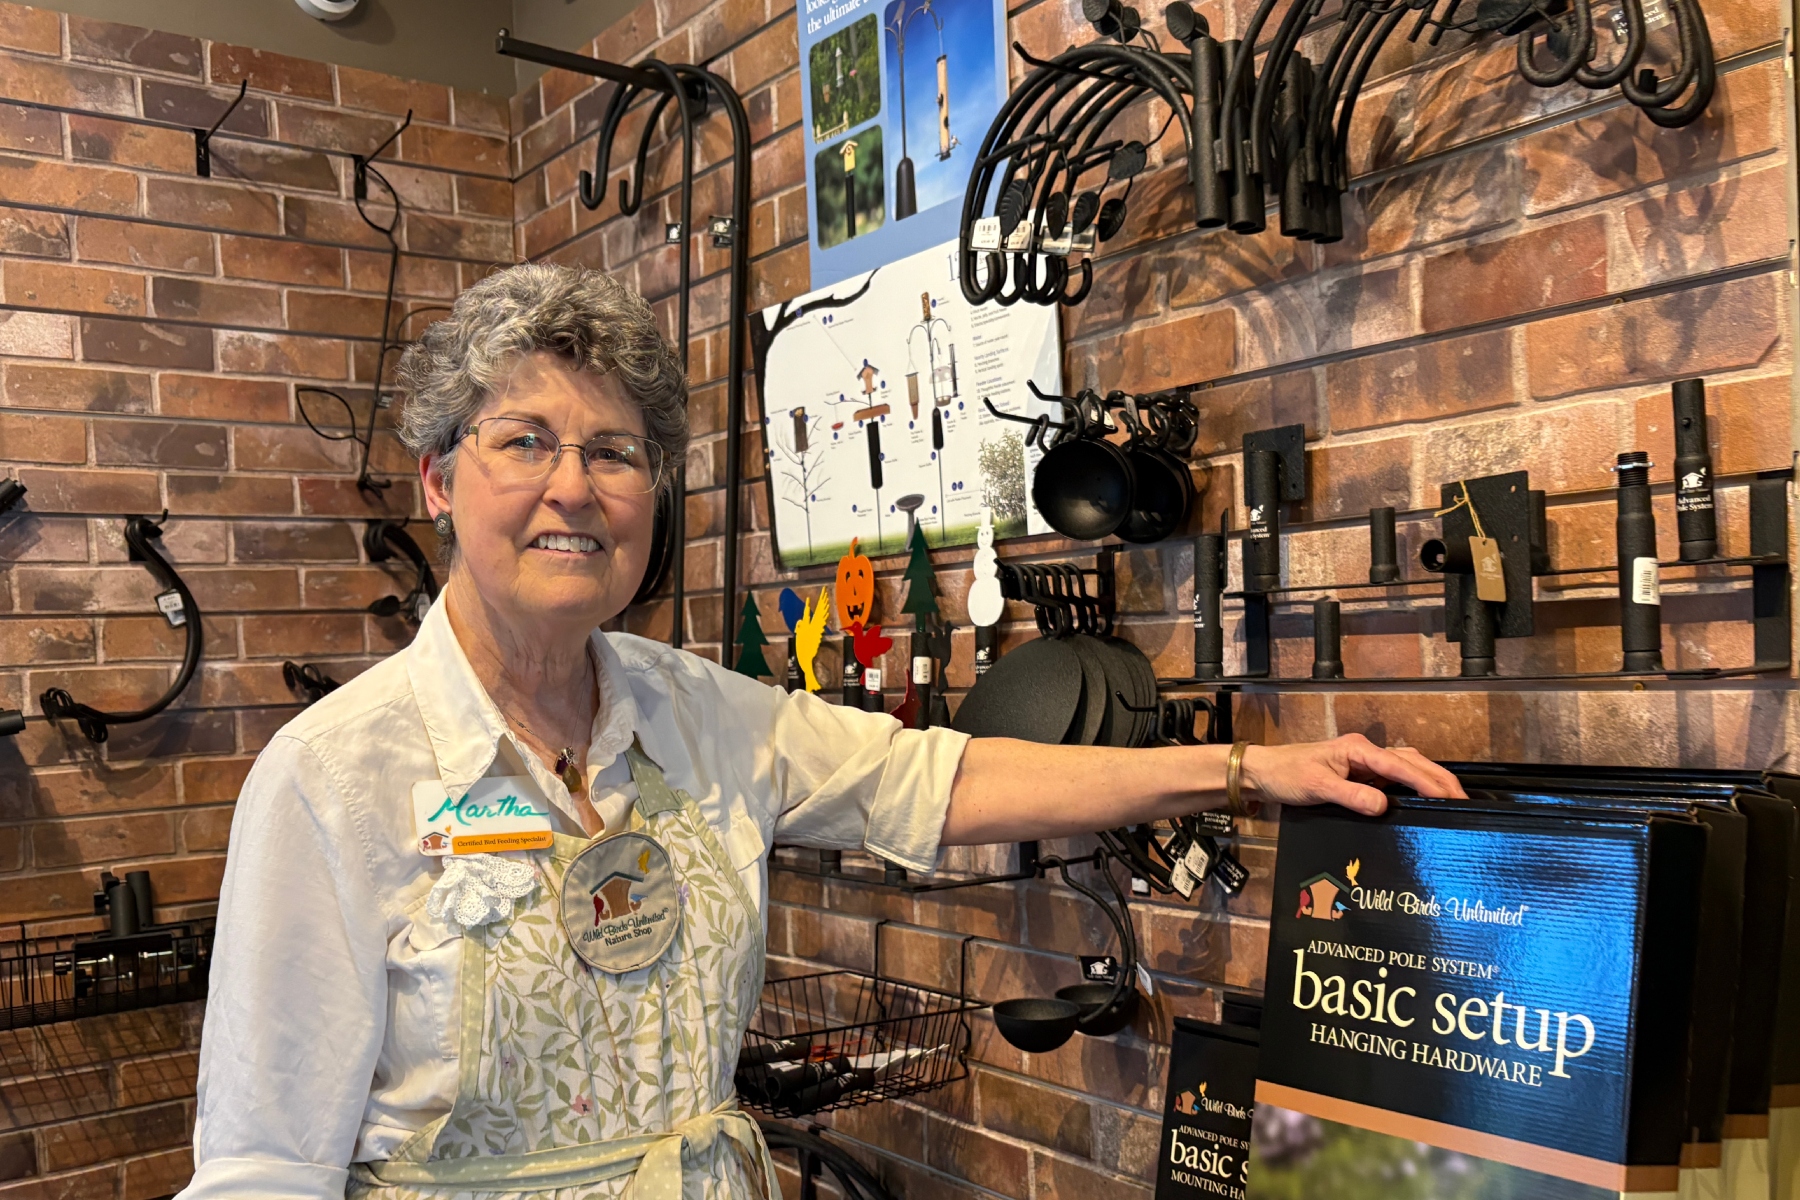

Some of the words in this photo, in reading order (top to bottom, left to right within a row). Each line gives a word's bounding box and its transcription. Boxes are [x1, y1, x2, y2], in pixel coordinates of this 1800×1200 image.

[807, 18, 822, 35] the
[823, 0, 860, 26] ultimate
[427, 793, 549, 826] Martha
[457, 839, 483, 847] Certified
[520, 835, 547, 844] Specialist
[1351, 886, 1394, 912] Wild
[1397, 891, 1441, 917] Birds
[1445, 896, 1525, 927] Unlimited
[583, 927, 604, 942] Wild
[604, 920, 629, 936] Birds
[628, 912, 667, 928] Unlimited
[605, 932, 632, 946] Nature
[633, 927, 652, 938] Shop
[1307, 939, 1385, 963] ADVANCED
[1389, 950, 1426, 970] POLE
[1432, 957, 1493, 980] SYSTEM
[1292, 948, 1416, 1028] basic
[1432, 991, 1596, 1079] setup
[1310, 1023, 1407, 1060] HANGING
[1412, 1042, 1543, 1087] HARDWARE
[1201, 1097, 1223, 1114] Wild
[1224, 1103, 1246, 1119] Birds
[1179, 1124, 1218, 1141] ADVANCED
[1219, 1135, 1239, 1148] POLE
[1170, 1129, 1233, 1178] basic
[1171, 1169, 1228, 1196] MOUNTING
